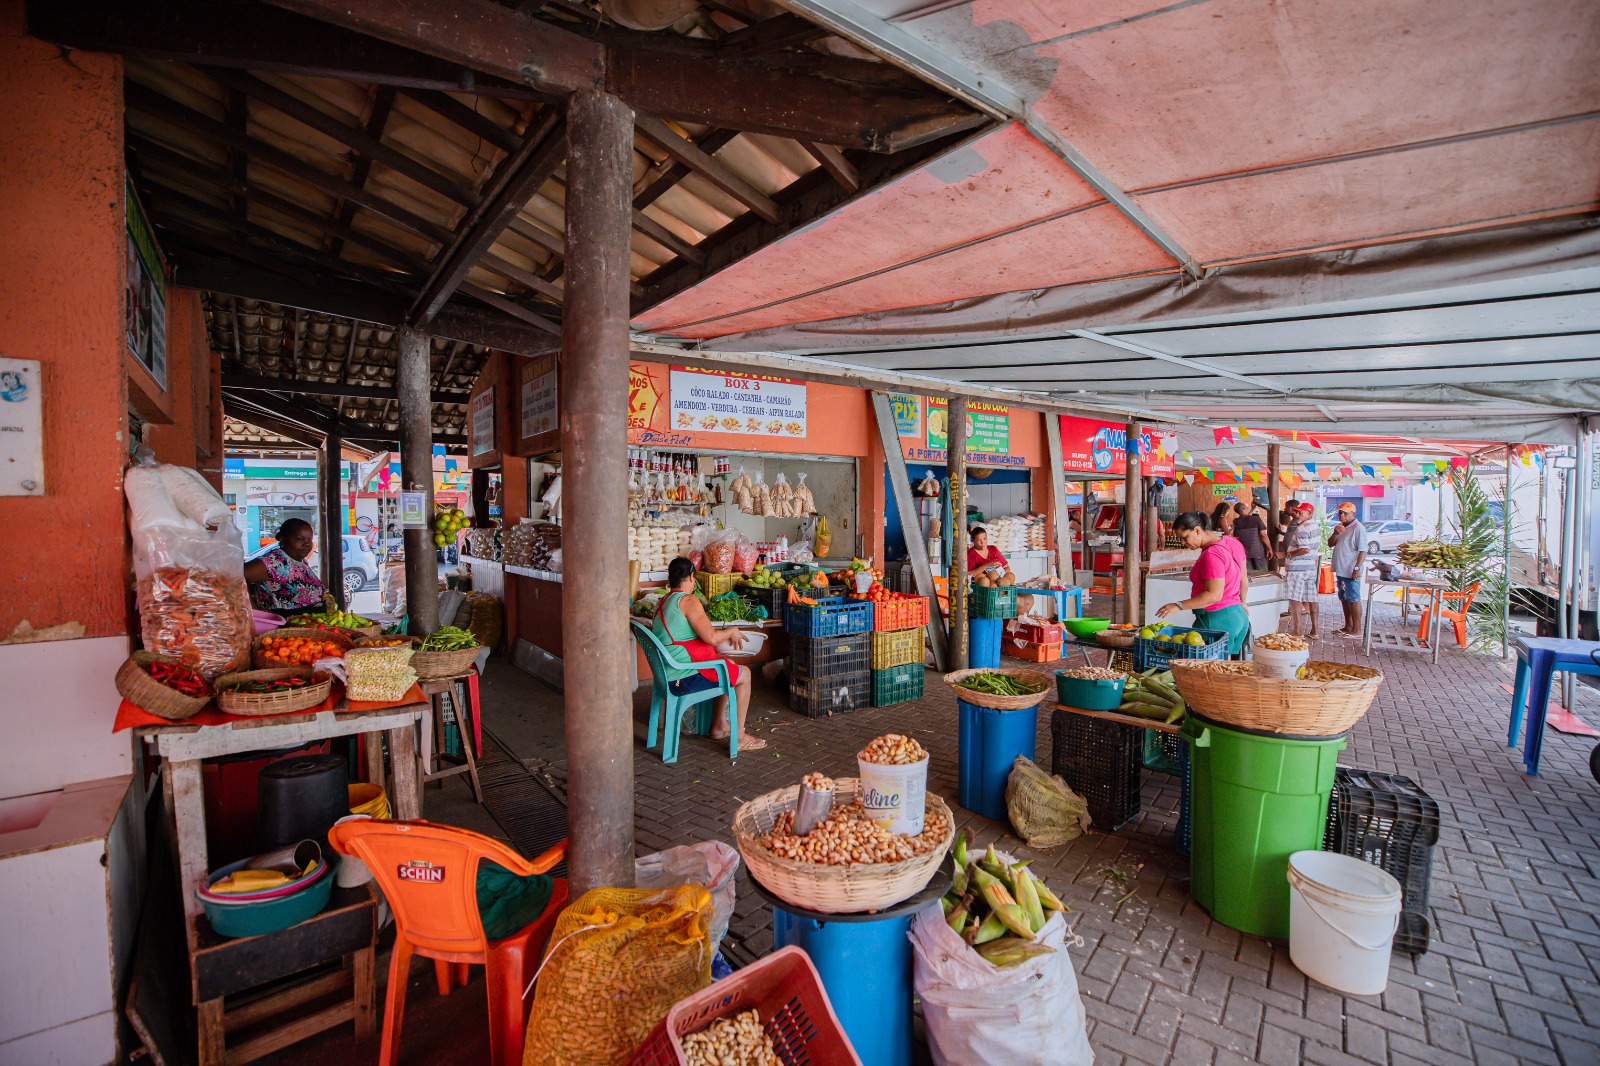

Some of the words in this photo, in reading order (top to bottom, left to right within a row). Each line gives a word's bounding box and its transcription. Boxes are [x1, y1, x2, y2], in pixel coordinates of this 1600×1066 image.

[724, 378, 750, 390] BOX
[754, 382, 760, 390] 3
[706, 390, 730, 400] RALADO
[734, 392, 762, 403] CASTANHA
[766, 396, 792, 406] CAMARÃO
[640, 402, 646, 410] E
[674, 400, 706, 410] AMENDOIM
[710, 403, 738, 413] VERDURA
[742, 406, 764, 416] CEREAIS
[769, 408, 783, 417] AIPIM
[784, 410, 804, 419] RALADO
[894, 402, 917, 420] PIX
[908, 448, 914, 457] A
[918, 449, 941, 459] PORTA
[973, 454, 987, 462] ABRE
[400, 867, 441, 880] SCHIN
